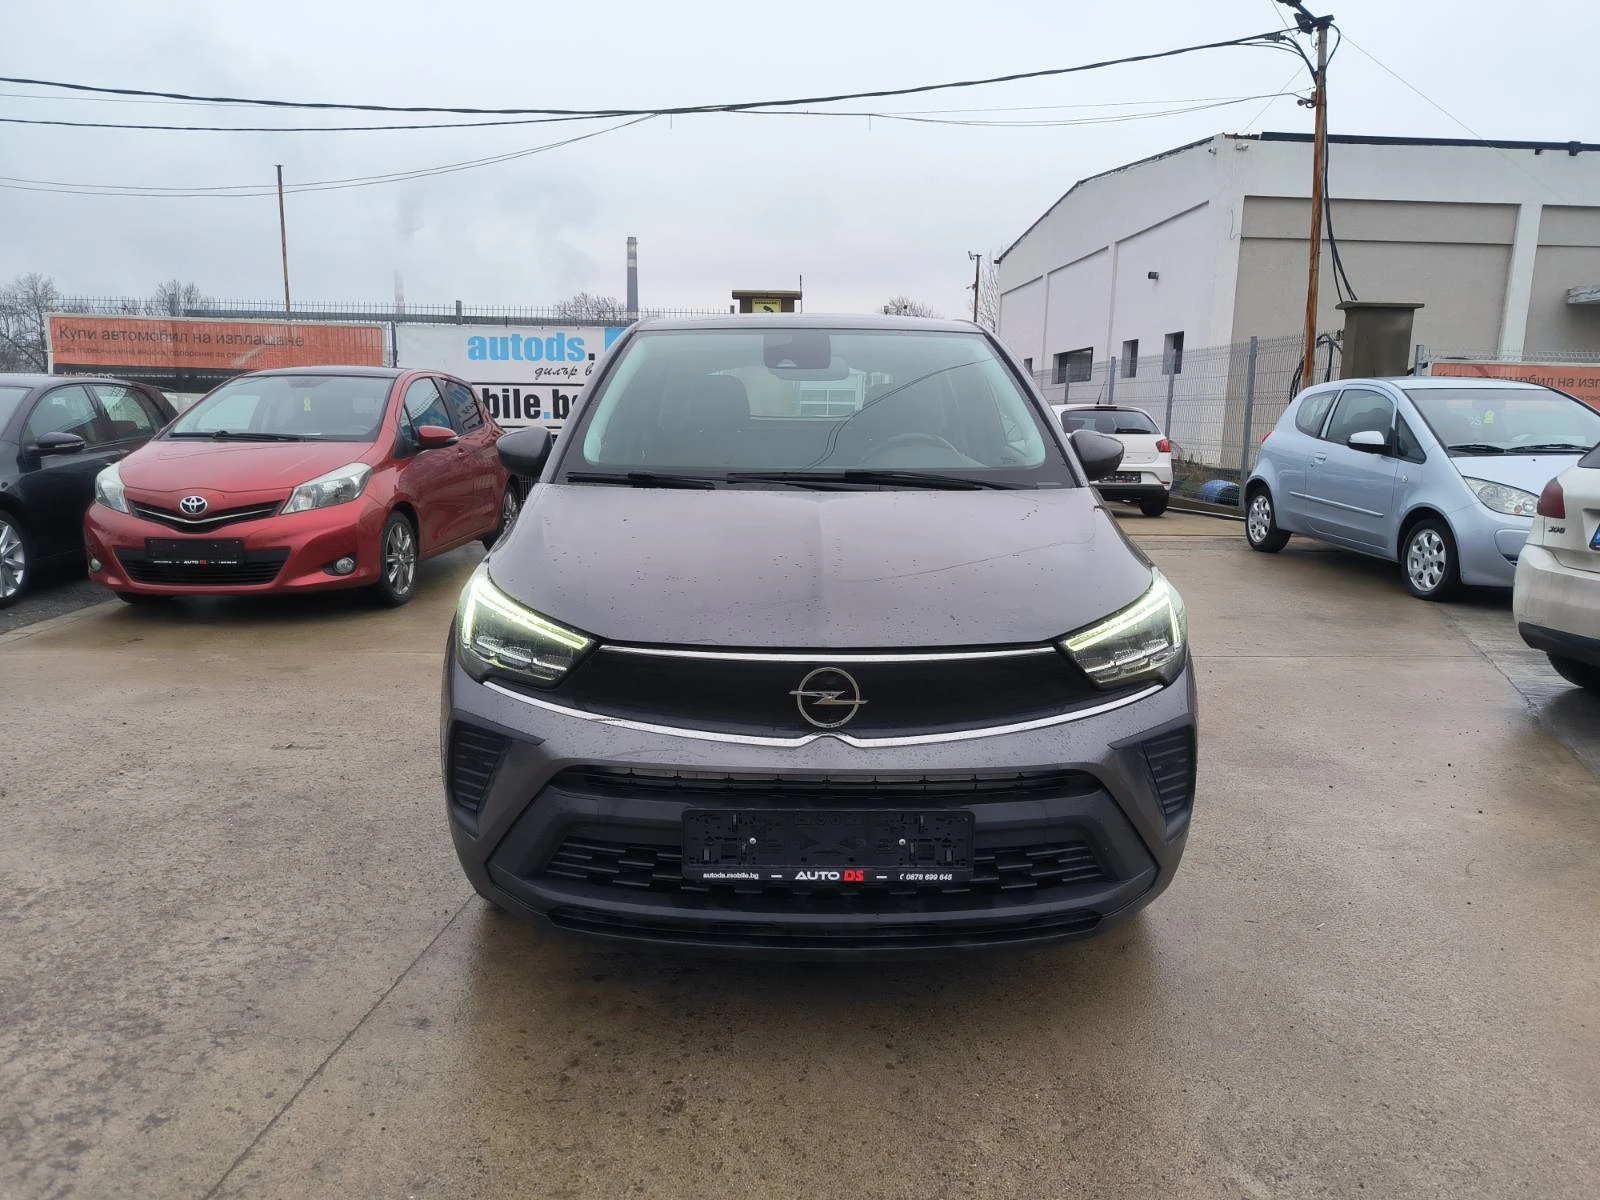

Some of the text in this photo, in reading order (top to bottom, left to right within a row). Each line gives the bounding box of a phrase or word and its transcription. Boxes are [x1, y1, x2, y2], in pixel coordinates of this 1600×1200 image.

[59, 326, 304, 347] Купи автомобил на изплащане
[1558, 377, 1574, 387] на
[482, 388, 578, 419] bile.b
[795, 871, 840, 880] AUTO
[844, 871, 864, 881] DS
